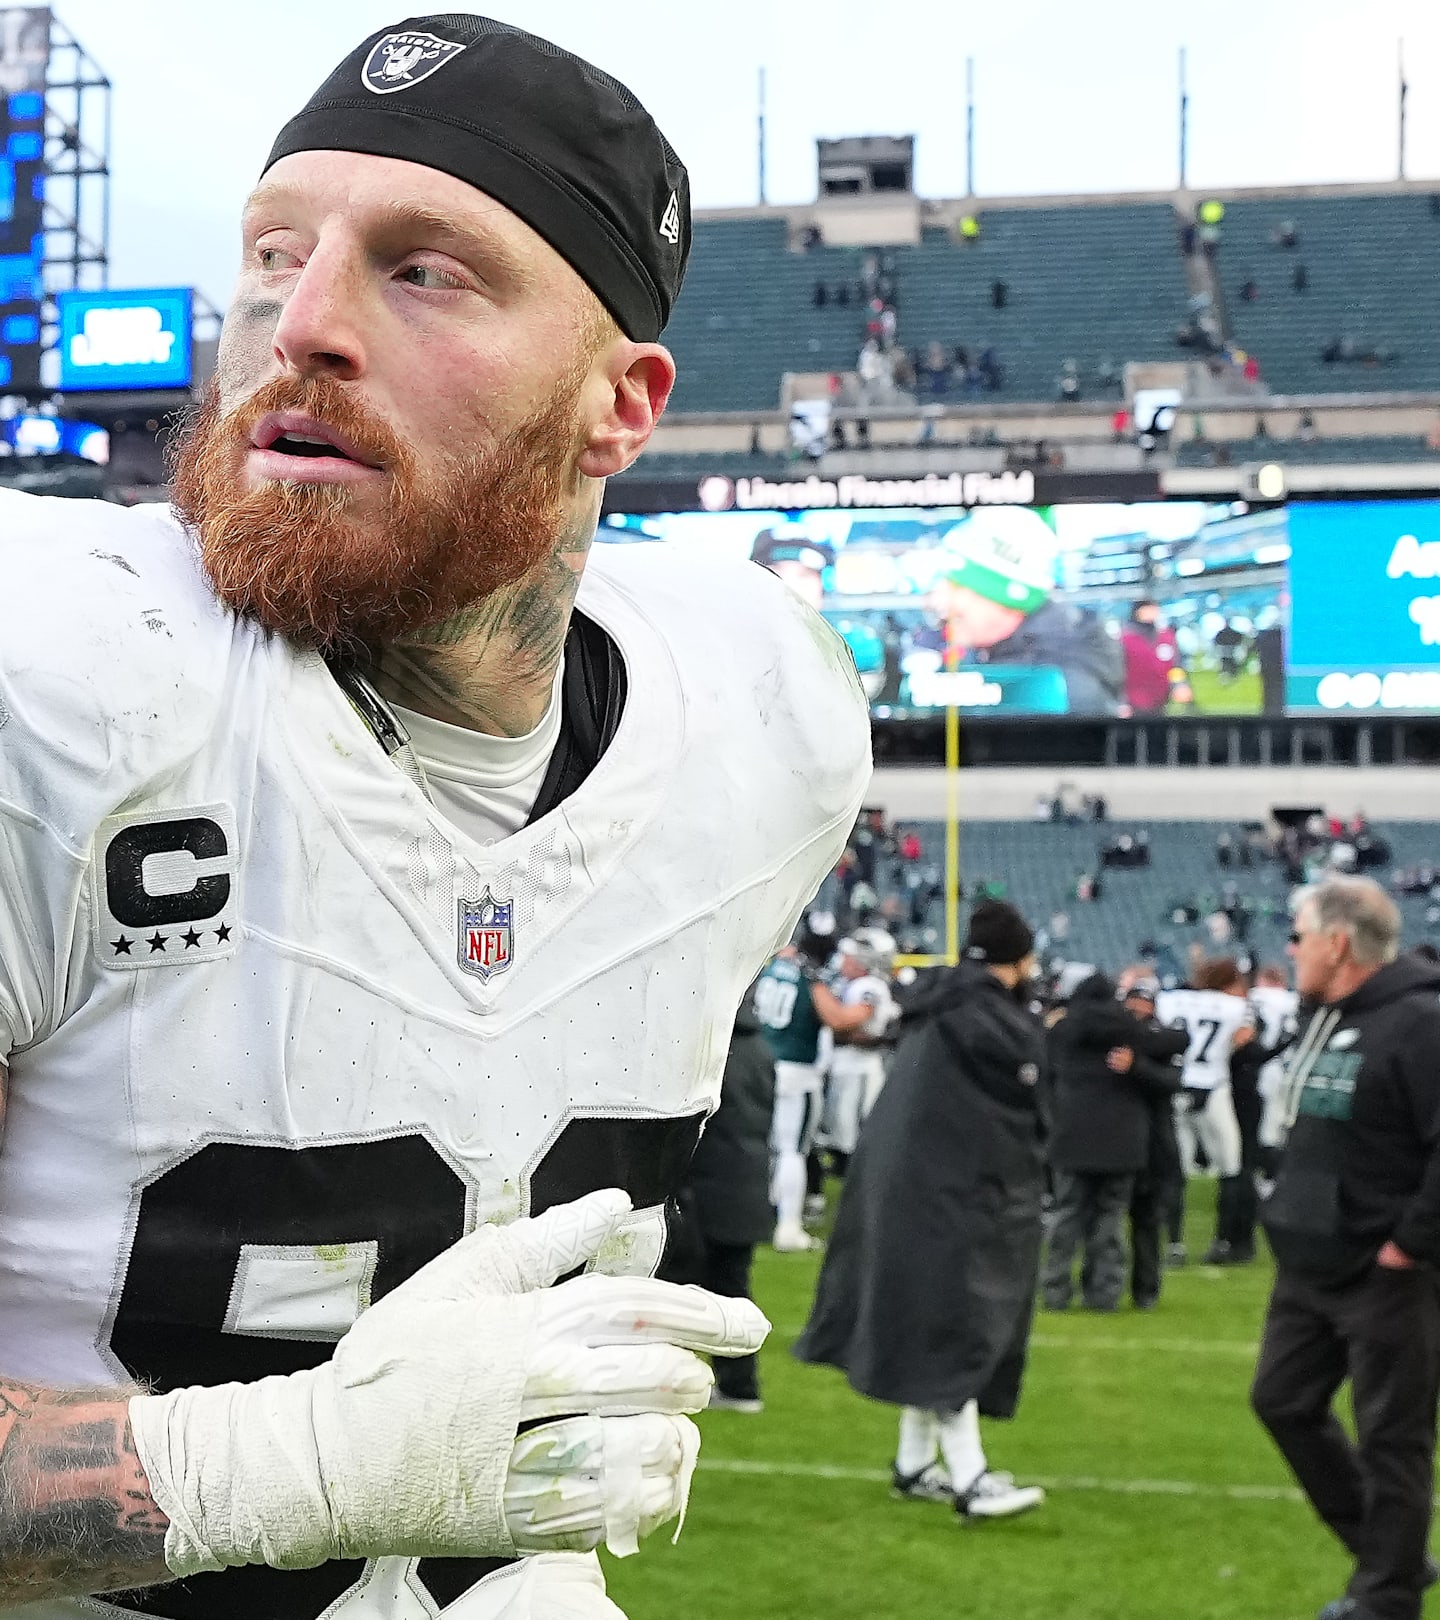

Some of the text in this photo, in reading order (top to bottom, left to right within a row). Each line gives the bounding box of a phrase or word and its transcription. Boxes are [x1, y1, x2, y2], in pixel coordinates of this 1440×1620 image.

[388, 35, 453, 52] RAIDERS
[735, 470, 1035, 509] Lincoln Financial Field
[105, 817, 231, 928] C
[468, 929, 508, 967] NFL
